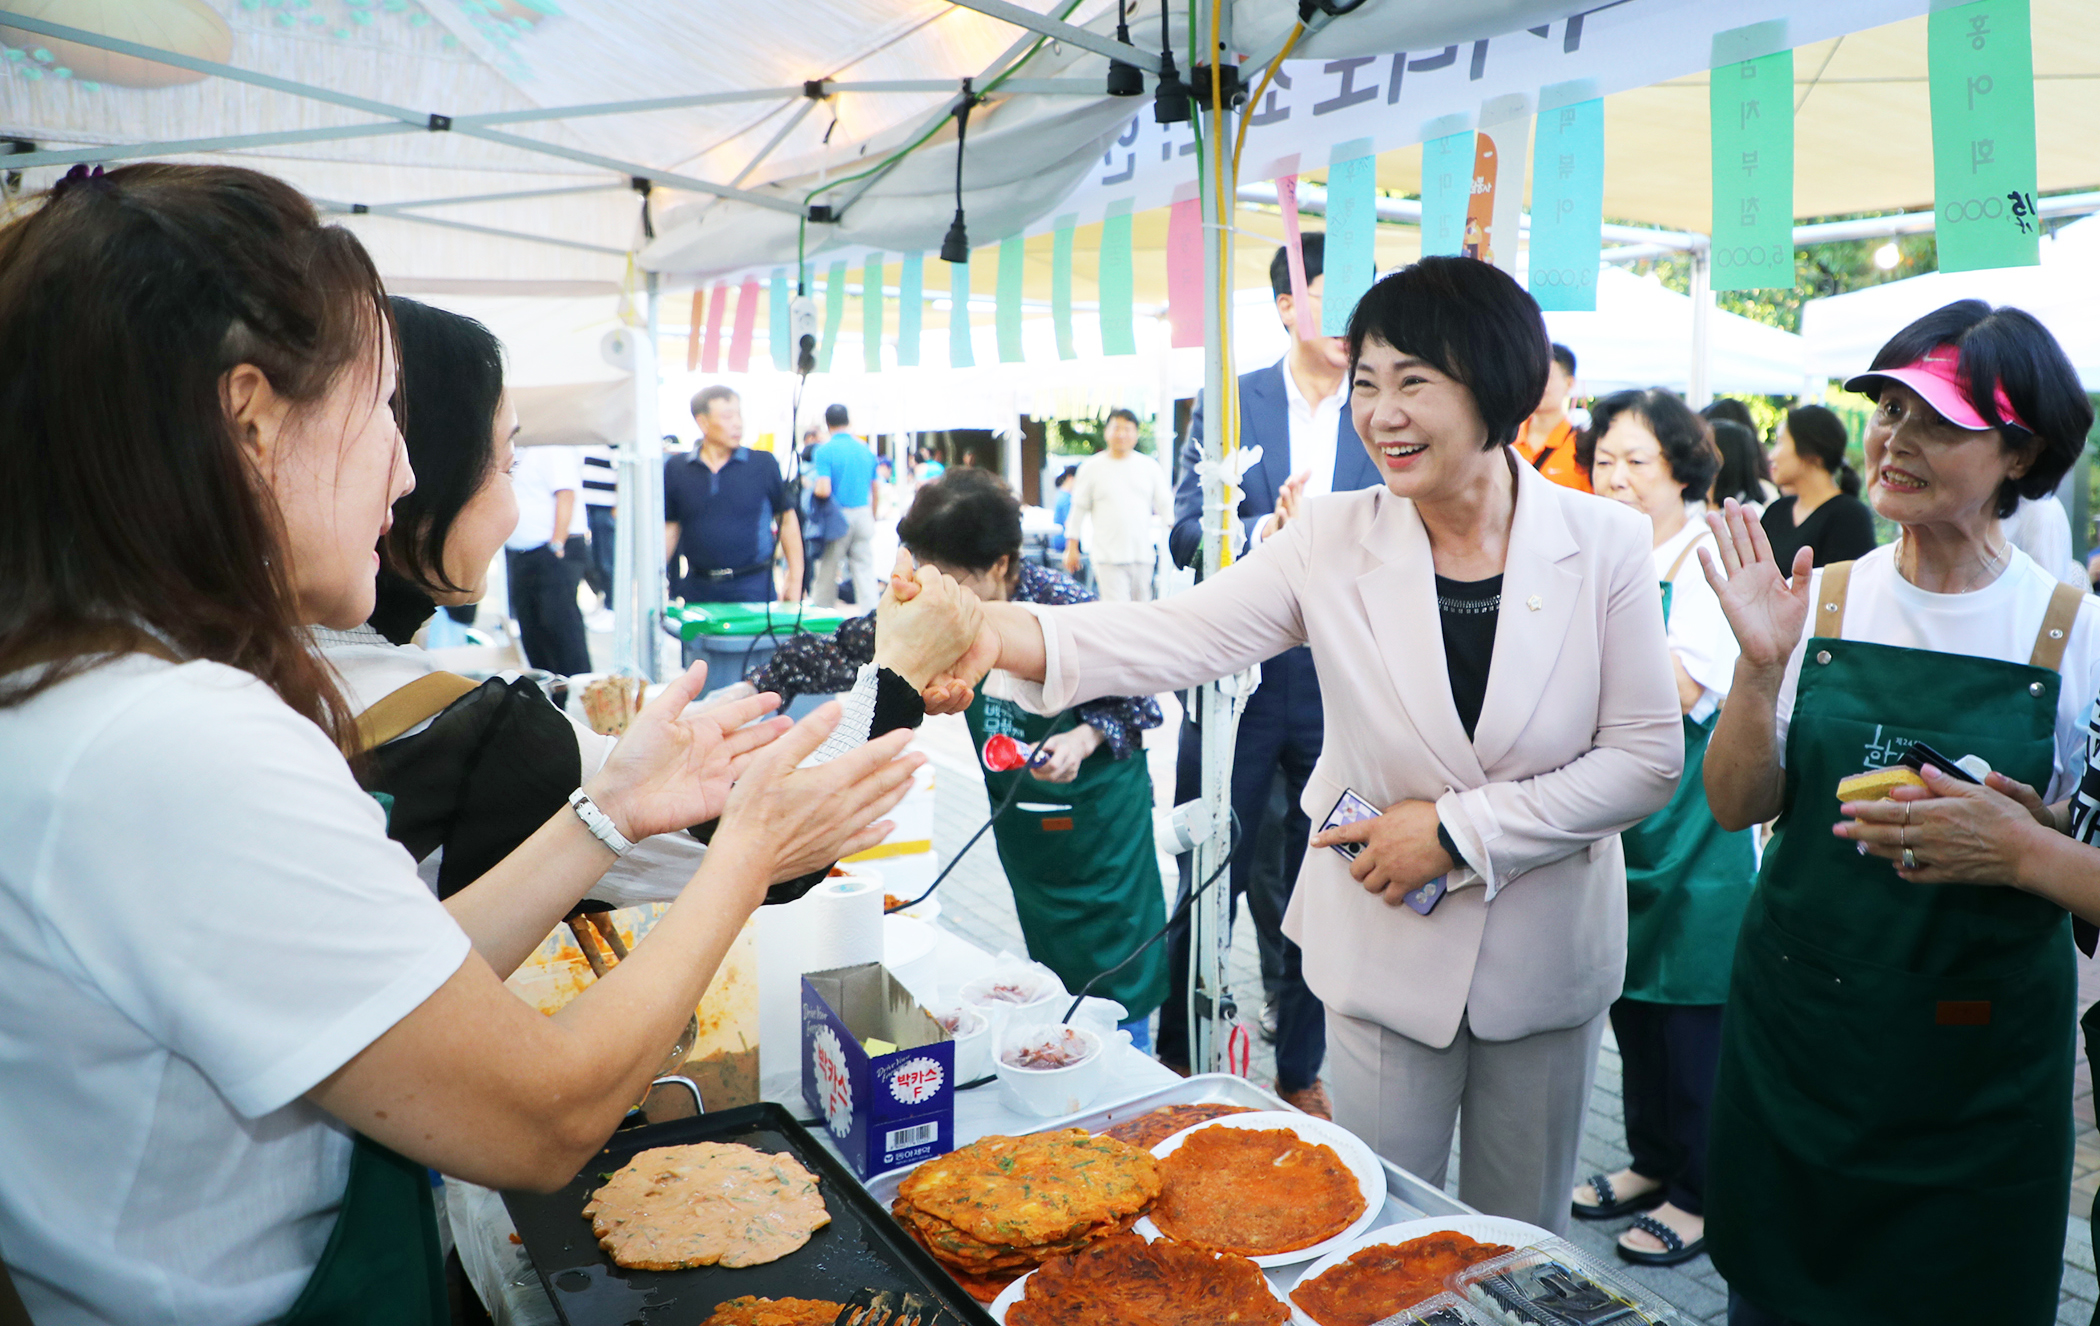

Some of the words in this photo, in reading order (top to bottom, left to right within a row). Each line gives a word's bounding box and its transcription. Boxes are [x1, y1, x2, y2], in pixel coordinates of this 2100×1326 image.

[817, 1044, 849, 1108] 박카스
[897, 1068, 938, 1088] 박카스
[914, 1086, 923, 1099] F
[830, 1093, 838, 1118] F
